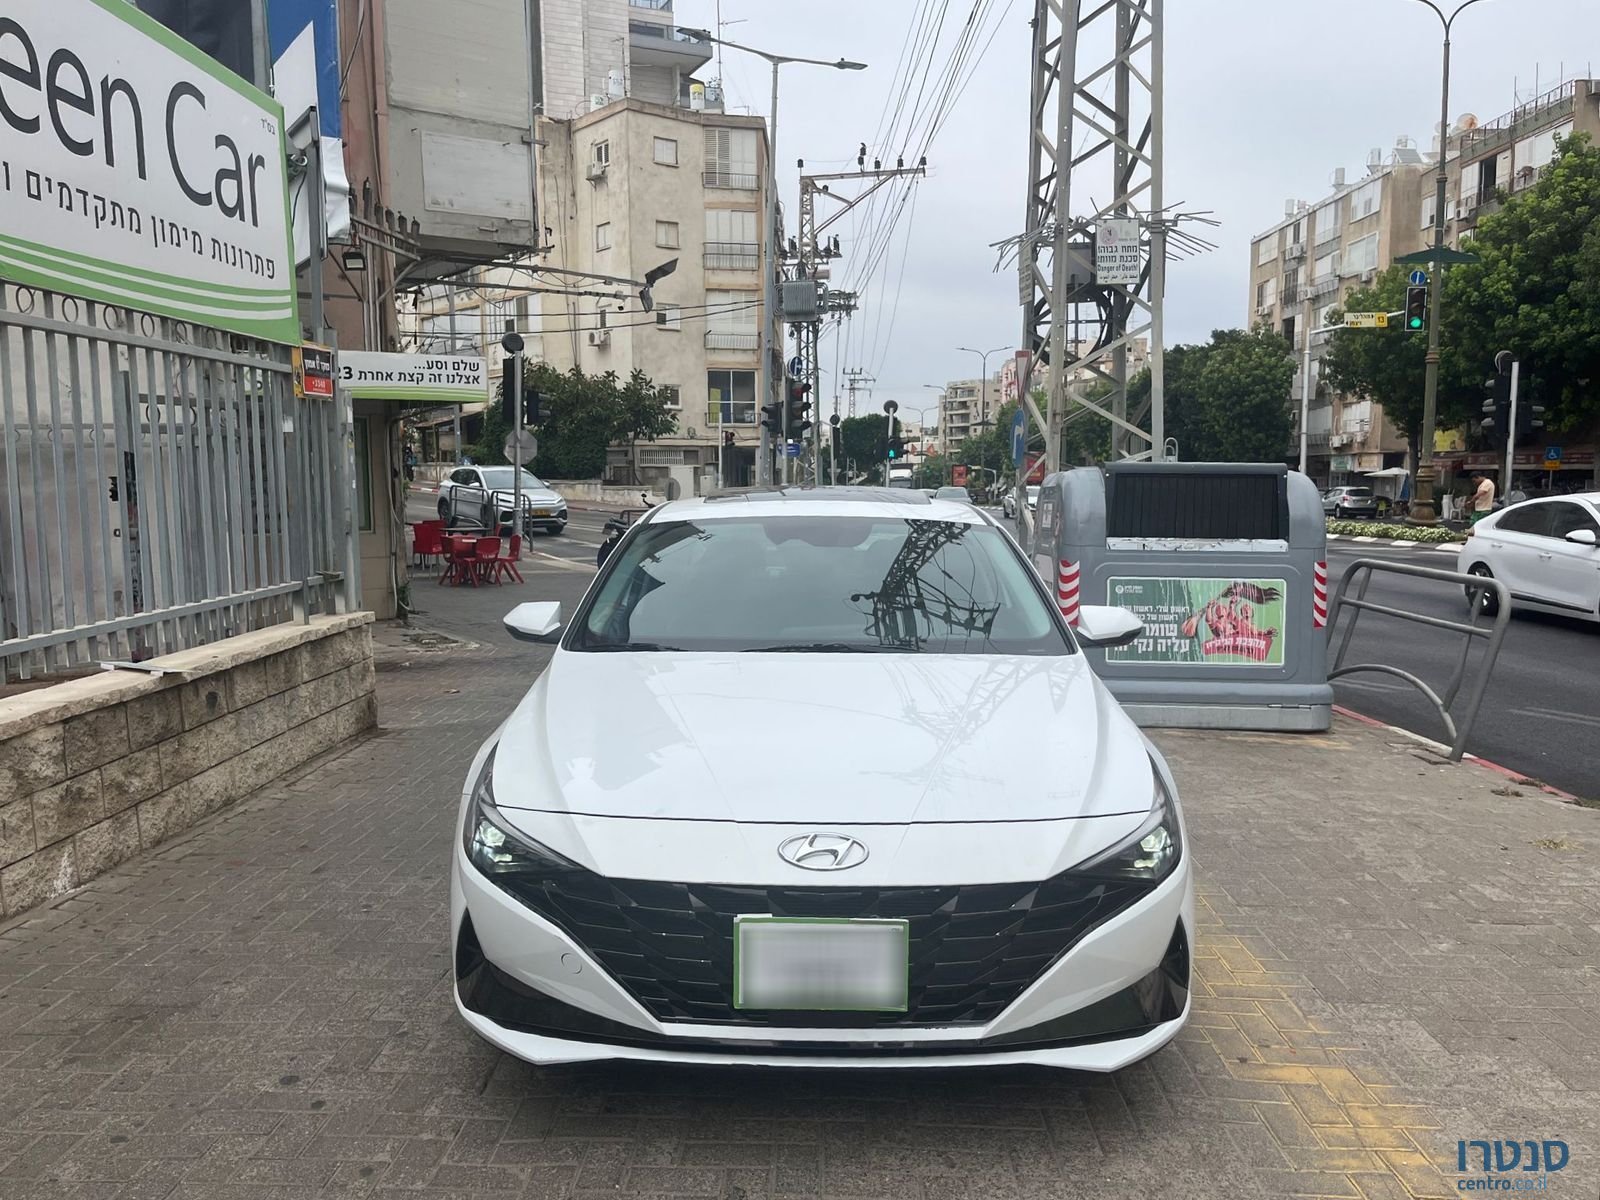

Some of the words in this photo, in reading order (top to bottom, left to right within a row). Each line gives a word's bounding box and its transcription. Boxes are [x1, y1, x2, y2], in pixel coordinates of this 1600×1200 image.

[165, 81, 266, 228] Car
[25, 169, 142, 235] מתקדמים
[150, 214, 204, 255] מימון
[1097, 245, 1118, 254] גבוה!
[1121, 245, 1138, 253] מתח
[210, 237, 276, 280] פתרונות
[1119, 255, 1138, 263] סכנת
[1097, 264, 1115, 273] Danger
[1115, 264, 1121, 272] of
[414, 360, 448, 371] וסע...
[452, 359, 480, 372] שלם
[358, 370, 394, 382] אחרת
[397, 371, 424, 385] קצת
[429, 373, 442, 383] זה
[446, 372, 480, 385] אצלנו
[1143, 623, 1178, 637] שומר
[1157, 637, 1190, 653] עליה
